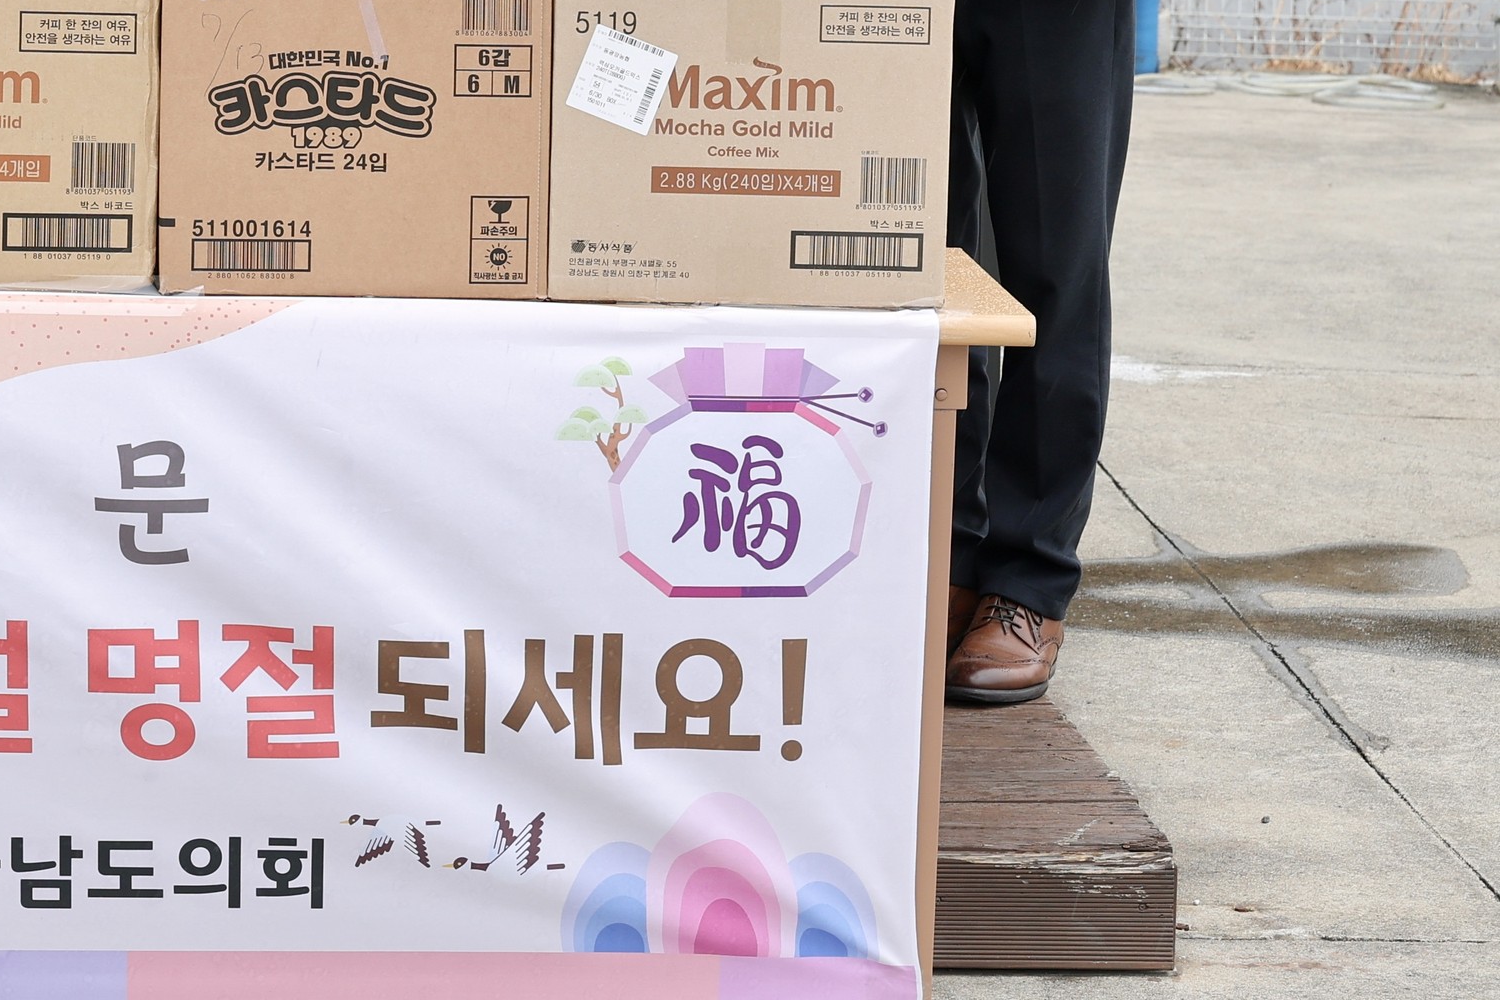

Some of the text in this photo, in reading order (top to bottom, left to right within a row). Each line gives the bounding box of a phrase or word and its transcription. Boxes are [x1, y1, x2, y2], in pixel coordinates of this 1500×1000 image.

[838, 11, 859, 23] 커피
[863, 12, 873, 24] 한
[878, 12, 897, 24] 잔의
[39, 18, 61, 30] 커피
[65, 18, 77, 31] 한
[80, 19, 102, 31] 잔의
[825, 24, 925, 37] 안전을 생각하는 여유
[25, 32, 131, 45] 안전을 생각하는 여유
[268, 49, 390, 70] 대한민국 No.1
[478, 49, 511, 67] 6갑
[467, 74, 520, 94] 6 M
[660, 57, 836, 112] Maxim
[210, 70, 437, 138] 카스타드
[654, 118, 833, 139] Mocha Gold Mild
[291, 125, 363, 149] 1989
[707, 146, 780, 158] Coffee Mix
[254, 152, 388, 173] 카스타드 24입
[659, 172, 696, 189] 2.88
[80, 200, 133, 210] 박스 바코드
[192, 219, 311, 238] 511001614
[480, 225, 518, 237] 파손주의
[870, 219, 924, 230] 박스 바코드
[587, 241, 635, 254] 동서식품
[492, 252, 506, 261] NO
[568, 258, 609, 267] 인천광역시
[612, 258, 637, 268] 부평구
[667, 259, 677, 268] 55
[473, 272, 524, 281] 직사광선 노출 금지
[568, 268, 599, 277] 경상남도
[601, 268, 625, 278] 창원시
[628, 269, 651, 278] 의창구
[679, 270, 690, 279] 40
[672, 434, 801, 570] 福
[87, 620, 340, 761] 명절
[370, 629, 809, 766] 되세요!
